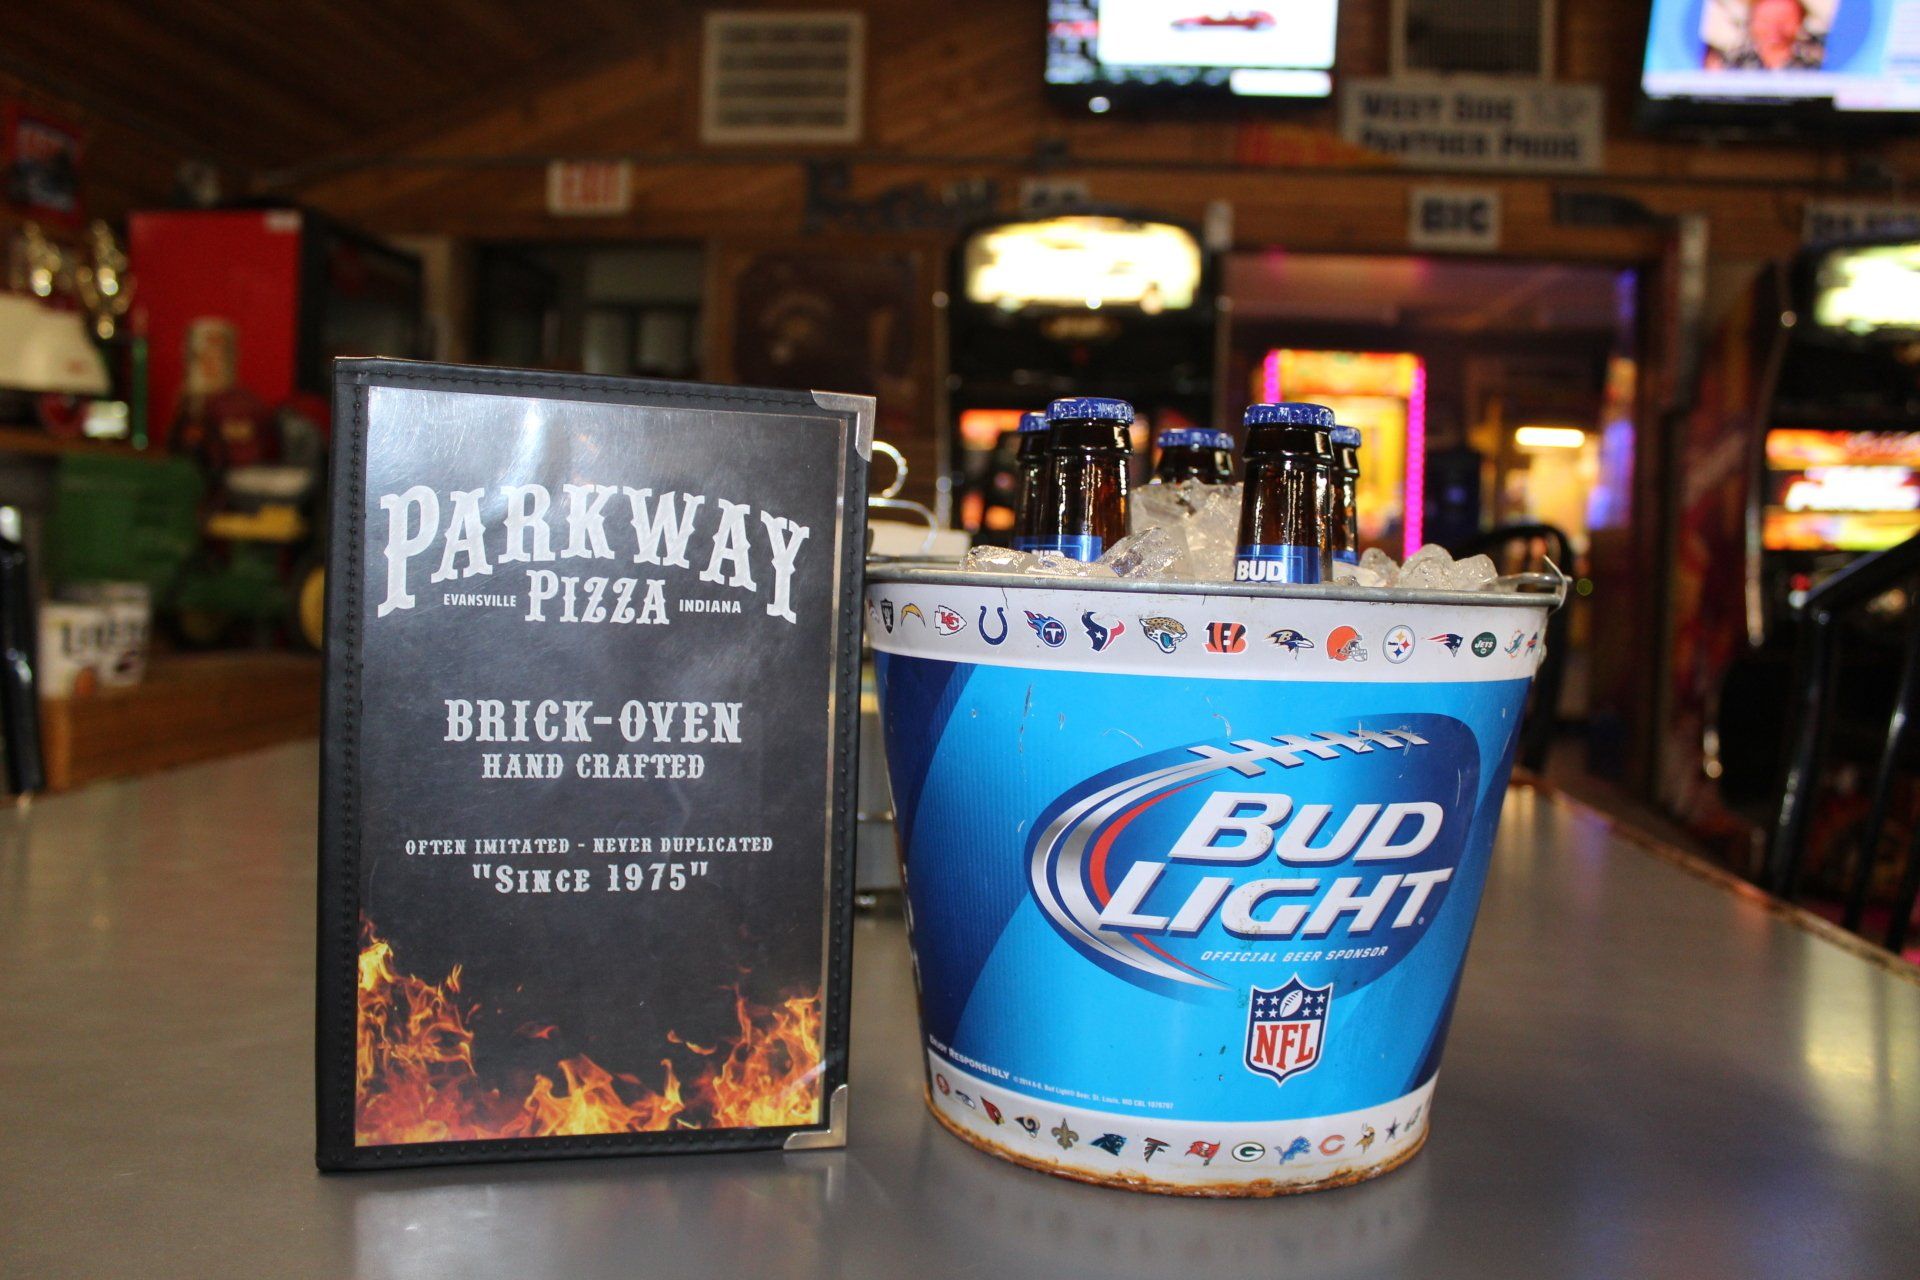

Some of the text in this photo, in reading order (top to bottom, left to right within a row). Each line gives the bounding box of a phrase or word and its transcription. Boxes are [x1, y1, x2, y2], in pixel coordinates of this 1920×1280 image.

[377, 484, 809, 624] PARKWAY
[1236, 560, 1286, 582] BUD
[443, 593, 516, 608] EVANSVILLE
[525, 569, 670, 625] PIZZA
[679, 599, 742, 614] INDIANA
[1474, 639, 1493, 649] JETS
[444, 699, 743, 743] BRICK-OVEN
[481, 753, 705, 779] HAND CRAFTED
[1168, 791, 1444, 864] BUD
[405, 839, 467, 855] OFTEN
[474, 838, 570, 854] IMITATED
[593, 838, 653, 853] NEVER
[660, 837, 773, 852] DUPLICATED
[472, 861, 709, 893] "SINCE 1975"
[1098, 861, 1452, 938] LIGHT
[1200, 946, 1389, 962] OFFICIAL BEER SPONSOR
[1253, 1023, 1315, 1070] NFL
[948, 1047, 1009, 1079] RESPONSIBLY
